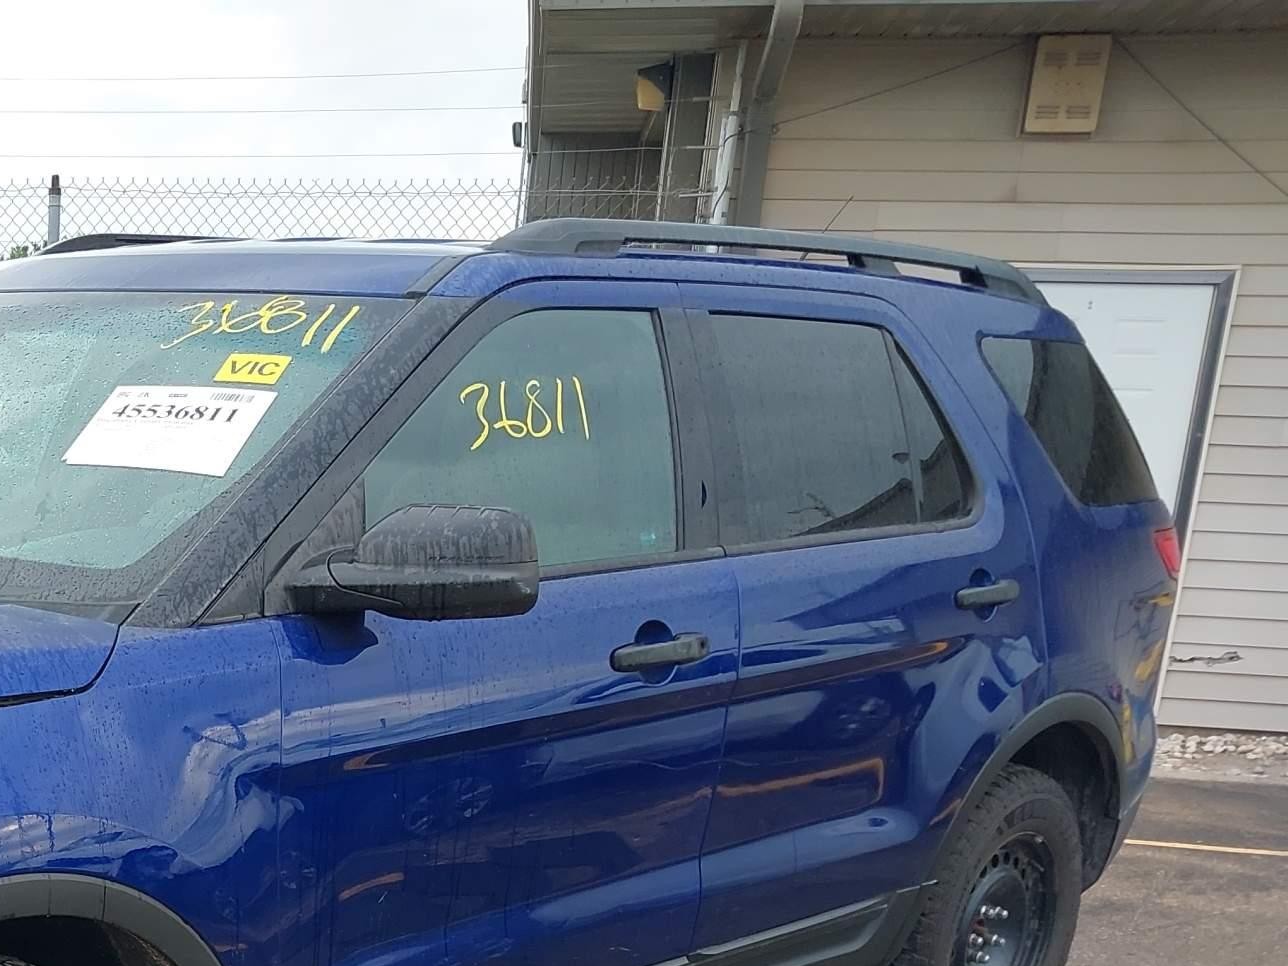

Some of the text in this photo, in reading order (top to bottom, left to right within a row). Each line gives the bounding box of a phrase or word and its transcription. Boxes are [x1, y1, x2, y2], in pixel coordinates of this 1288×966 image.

[230, 360, 281, 376] VIC
[112, 403, 238, 423] 45536811
[458, 376, 590, 451] 36811
